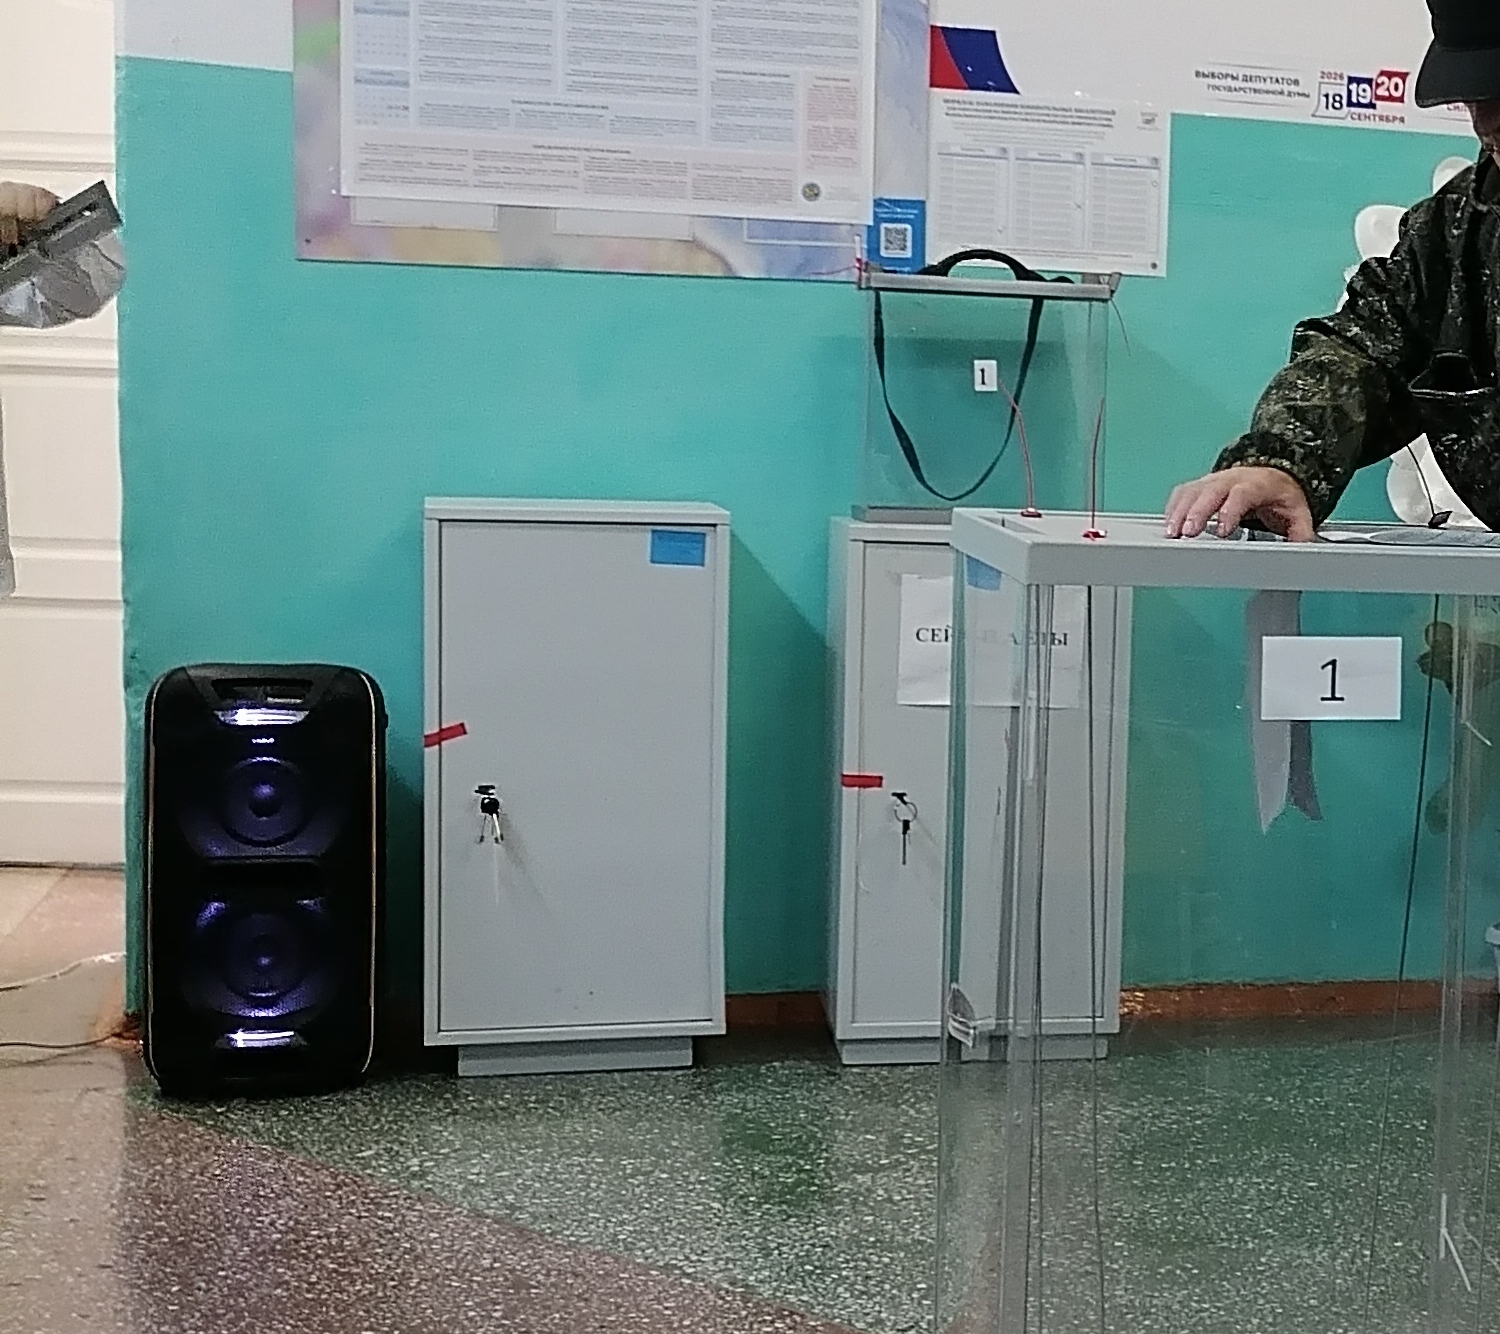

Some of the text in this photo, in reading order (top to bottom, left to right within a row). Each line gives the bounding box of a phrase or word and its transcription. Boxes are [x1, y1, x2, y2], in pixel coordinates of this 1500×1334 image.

[1195, 70, 1300, 87] ВЫБОРЫ ДЕПУТАТОВ
[1319, 70, 1345, 81] 2026
[1207, 83, 1310, 99] ГОСУДАРСТВЕННОЙ ДУМЫ
[1349, 82, 1372, 104] 19
[1376, 76, 1404, 98] 20
[1323, 92, 1344, 111] 18
[1350, 112, 1406, 124] СЕНТЯБРЯ
[979, 368, 989, 386] 1
[1319, 659, 1345, 702] 1
